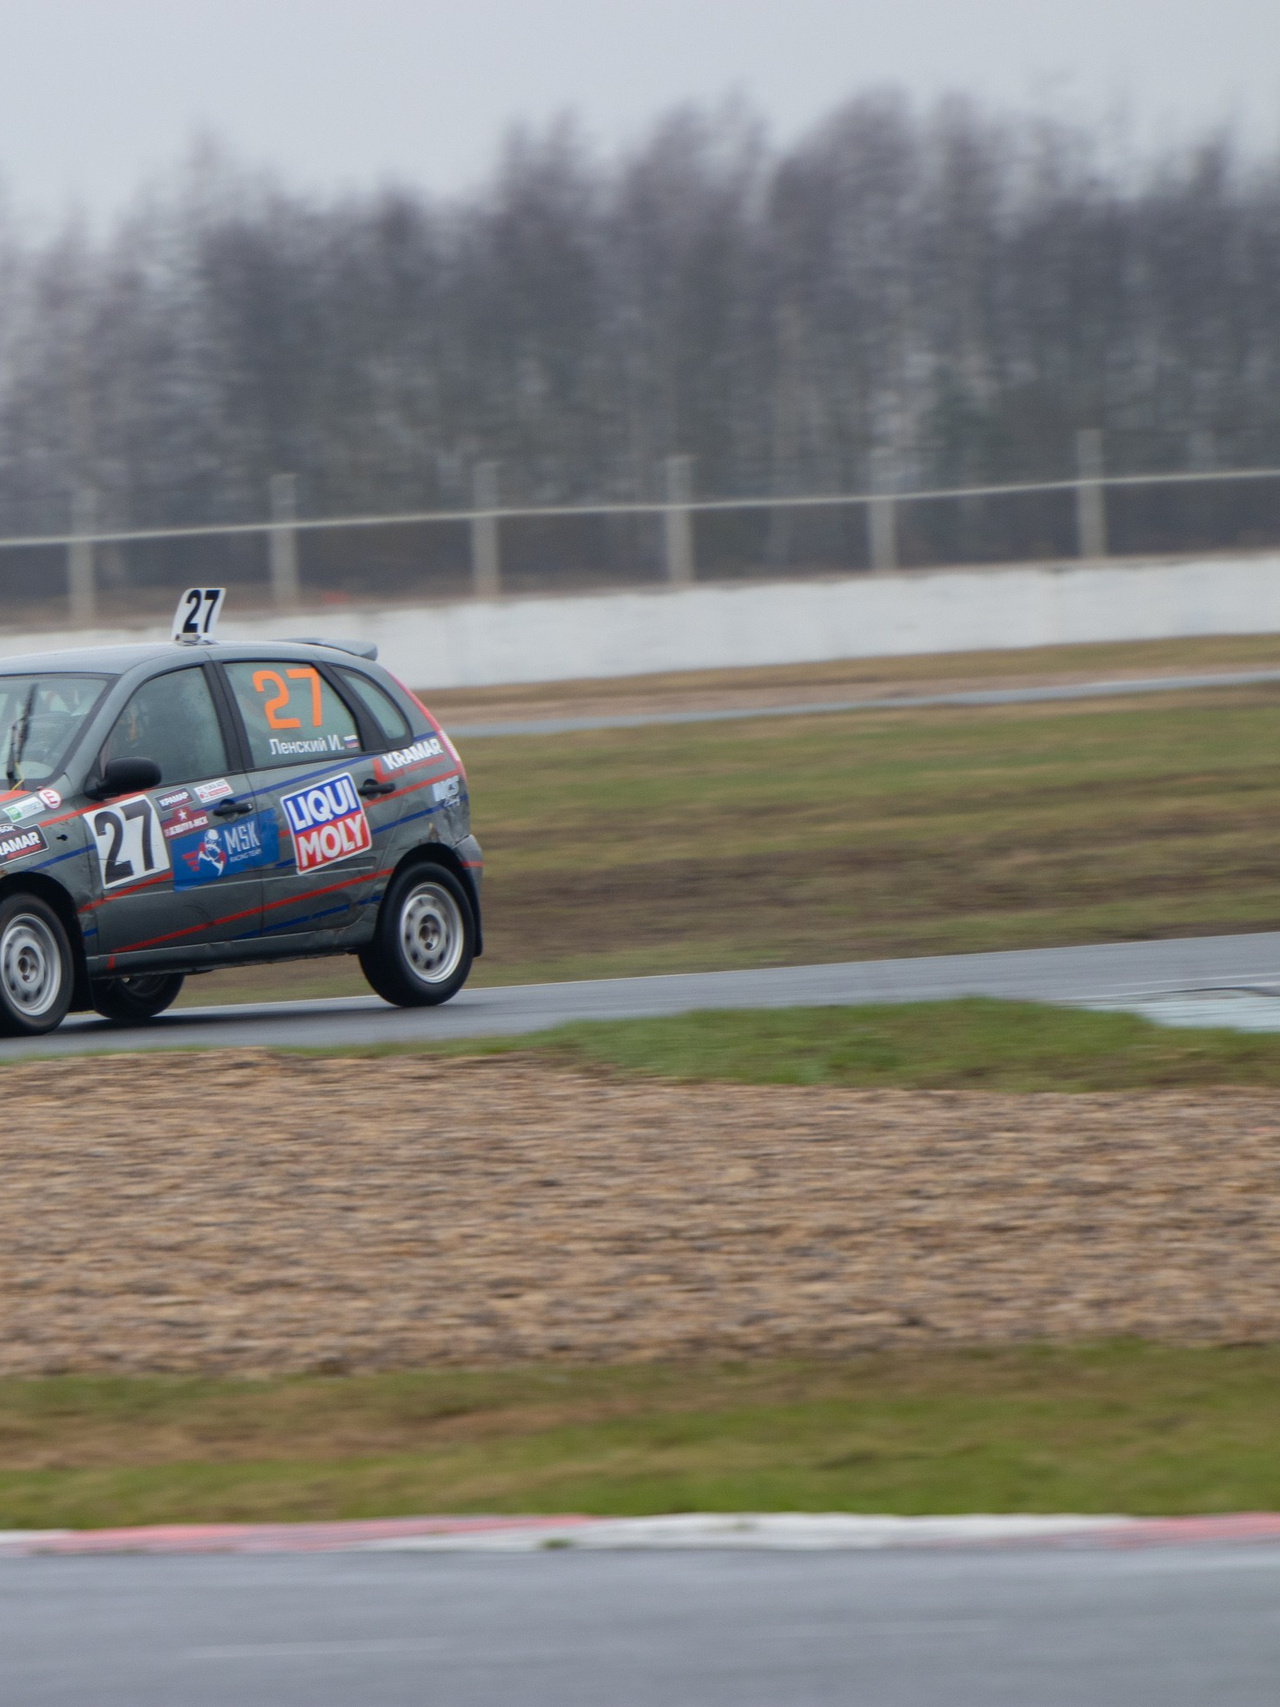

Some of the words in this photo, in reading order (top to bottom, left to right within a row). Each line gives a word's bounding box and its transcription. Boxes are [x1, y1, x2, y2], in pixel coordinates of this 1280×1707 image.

[182, 588, 221, 634] 27
[252, 667, 322, 729] 27
[269, 737, 328, 755] Ленский
[327, 734, 346, 751] И.
[382, 738, 443, 770] KRAMAR
[286, 778, 358, 831] LIQUI
[94, 799, 156, 885] 27
[224, 820, 261, 854] MSK
[298, 813, 364, 867] MOLY
